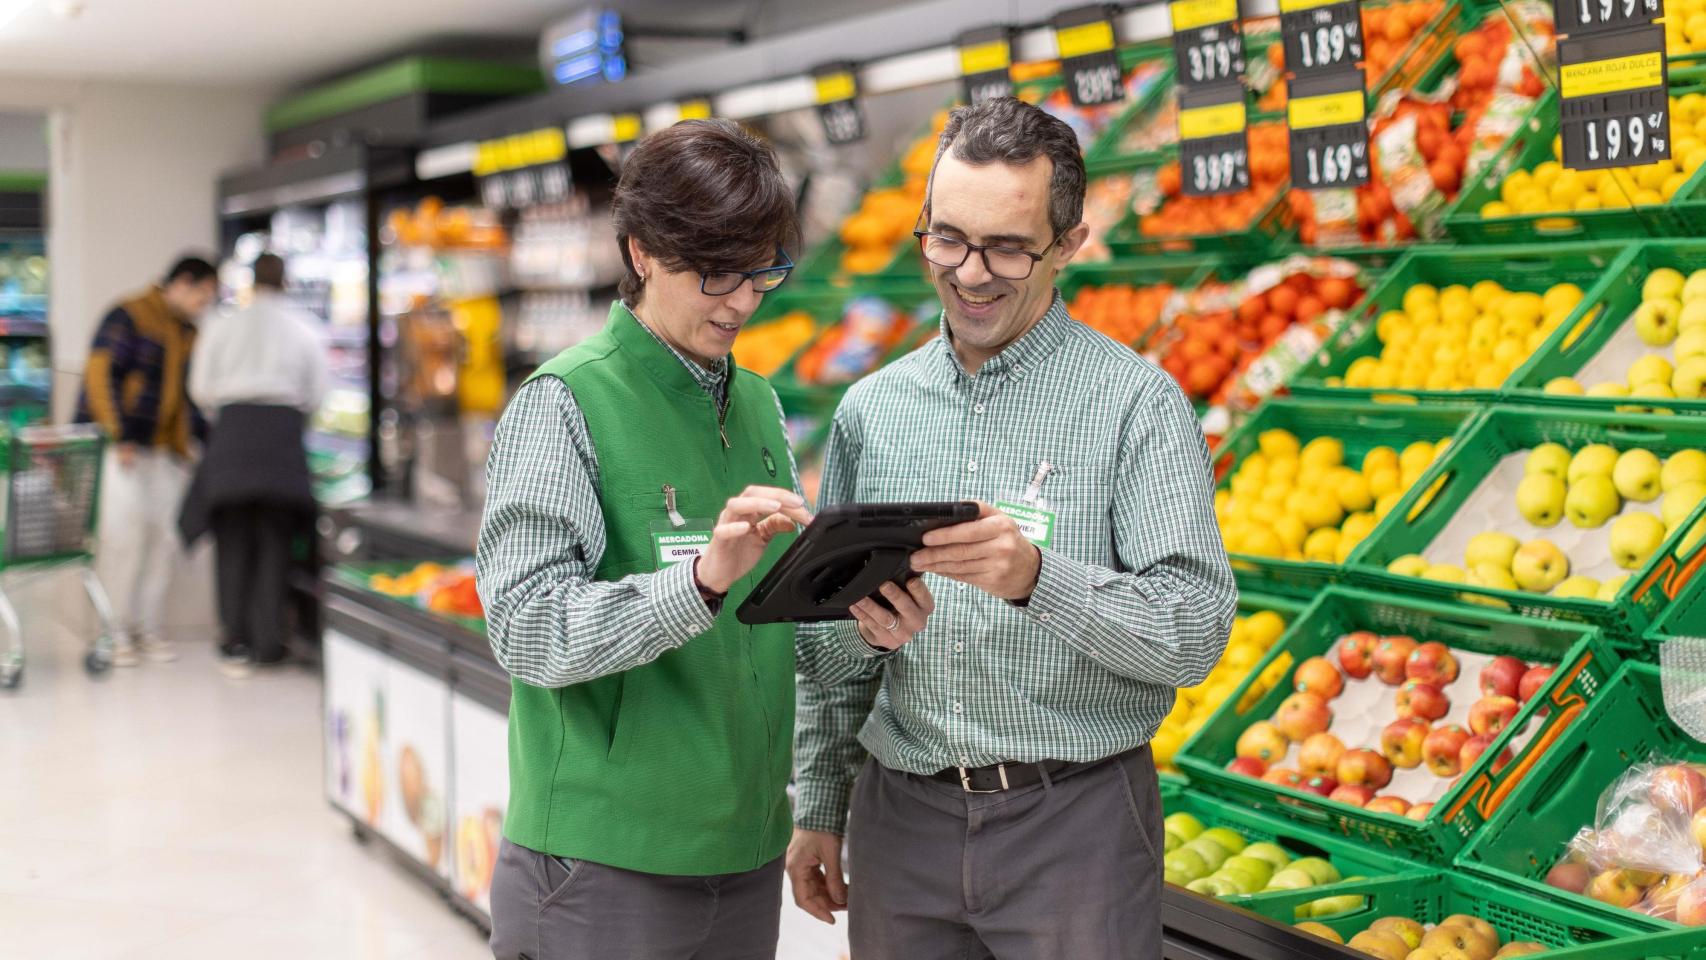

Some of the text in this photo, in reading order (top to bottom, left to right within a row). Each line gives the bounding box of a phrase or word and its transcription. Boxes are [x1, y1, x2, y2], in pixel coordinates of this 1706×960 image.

[1652, 137, 1665, 152] kg
[658, 534, 709, 544] MERCADONA
[671, 548, 700, 556] GEMMA
